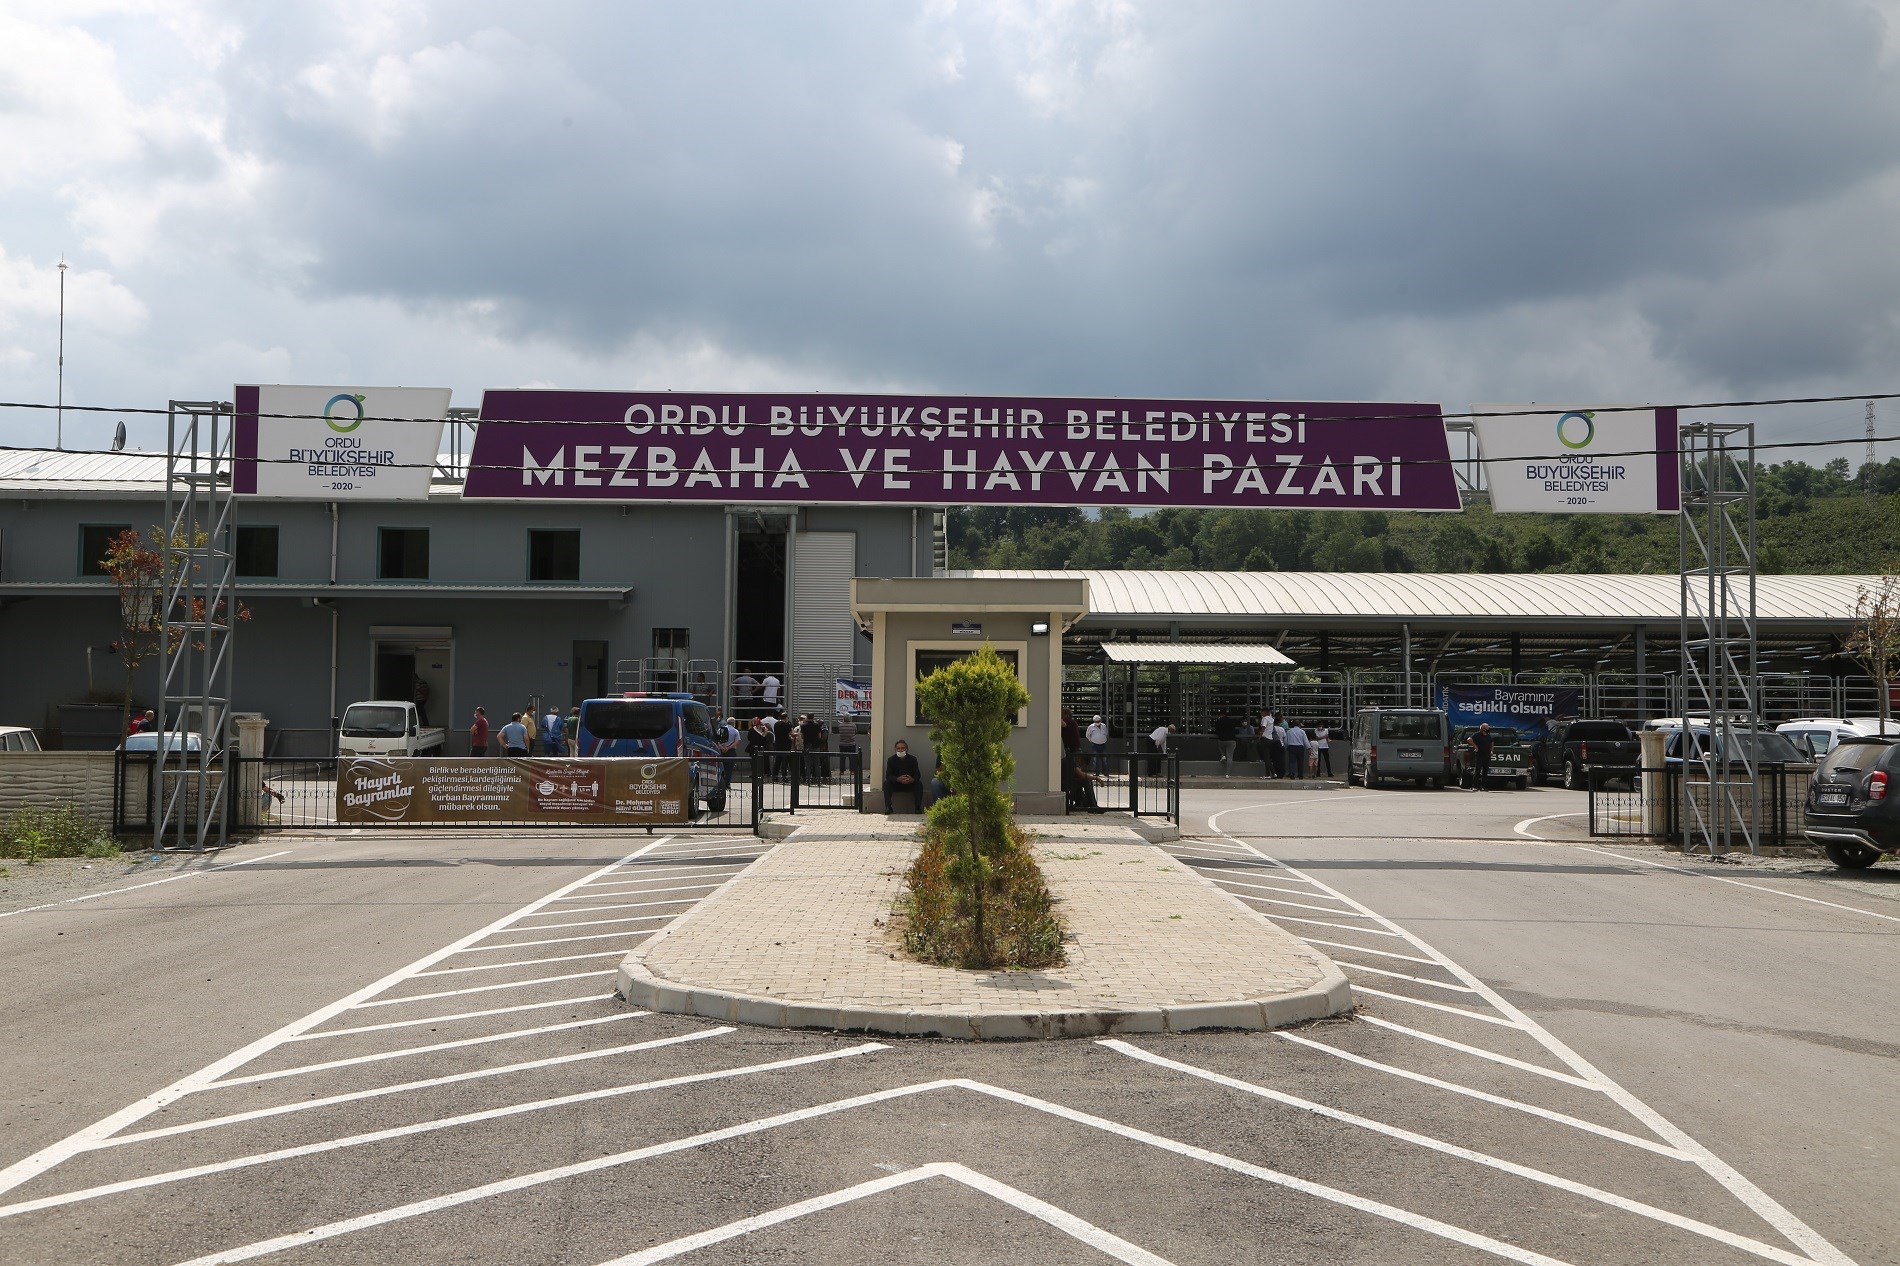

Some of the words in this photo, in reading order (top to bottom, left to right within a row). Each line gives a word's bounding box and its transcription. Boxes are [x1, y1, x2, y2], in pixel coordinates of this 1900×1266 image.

[624, 404, 746, 436] ORDU
[770, 405, 1044, 442] BÜYÜKŞEHİR
[1067, 409, 1306, 444] BELEDİYESİ
[325, 438, 361, 448] ORDU
[1559, 453, 1594, 464] ORDU
[308, 465, 376, 477] BELEDİYESİ
[522, 444, 810, 488] MEZBAHA
[839, 448, 912, 489] VE
[942, 449, 1170, 494] HAYVAN
[1203, 454, 1401, 496] PAZARI
[1526, 465, 1626, 481] BÜYÜKŞEHİR
[331, 482, 353, 491] 2020
[1544, 480, 1609, 492] BELEDİYESİ
[1566, 496, 1588, 505] 2020
[1494, 689, 1555, 703] Bayramınız
[1458, 700, 1507, 715] sağlıklı
[1510, 701, 1553, 715] olsun!
[429, 766, 450, 774] Birlik
[459, 766, 516, 775] beraberliğimizi
[354, 772, 403, 790] Hayırlı
[428, 784, 482, 794] güçlendirmesi
[482, 784, 514, 794] dileğiyle
[343, 784, 415, 807] Bayramlar
[462, 794, 510, 802] Bayramımız
[439, 803, 475, 811] mübarek
[476, 803, 501, 811] olsun.
